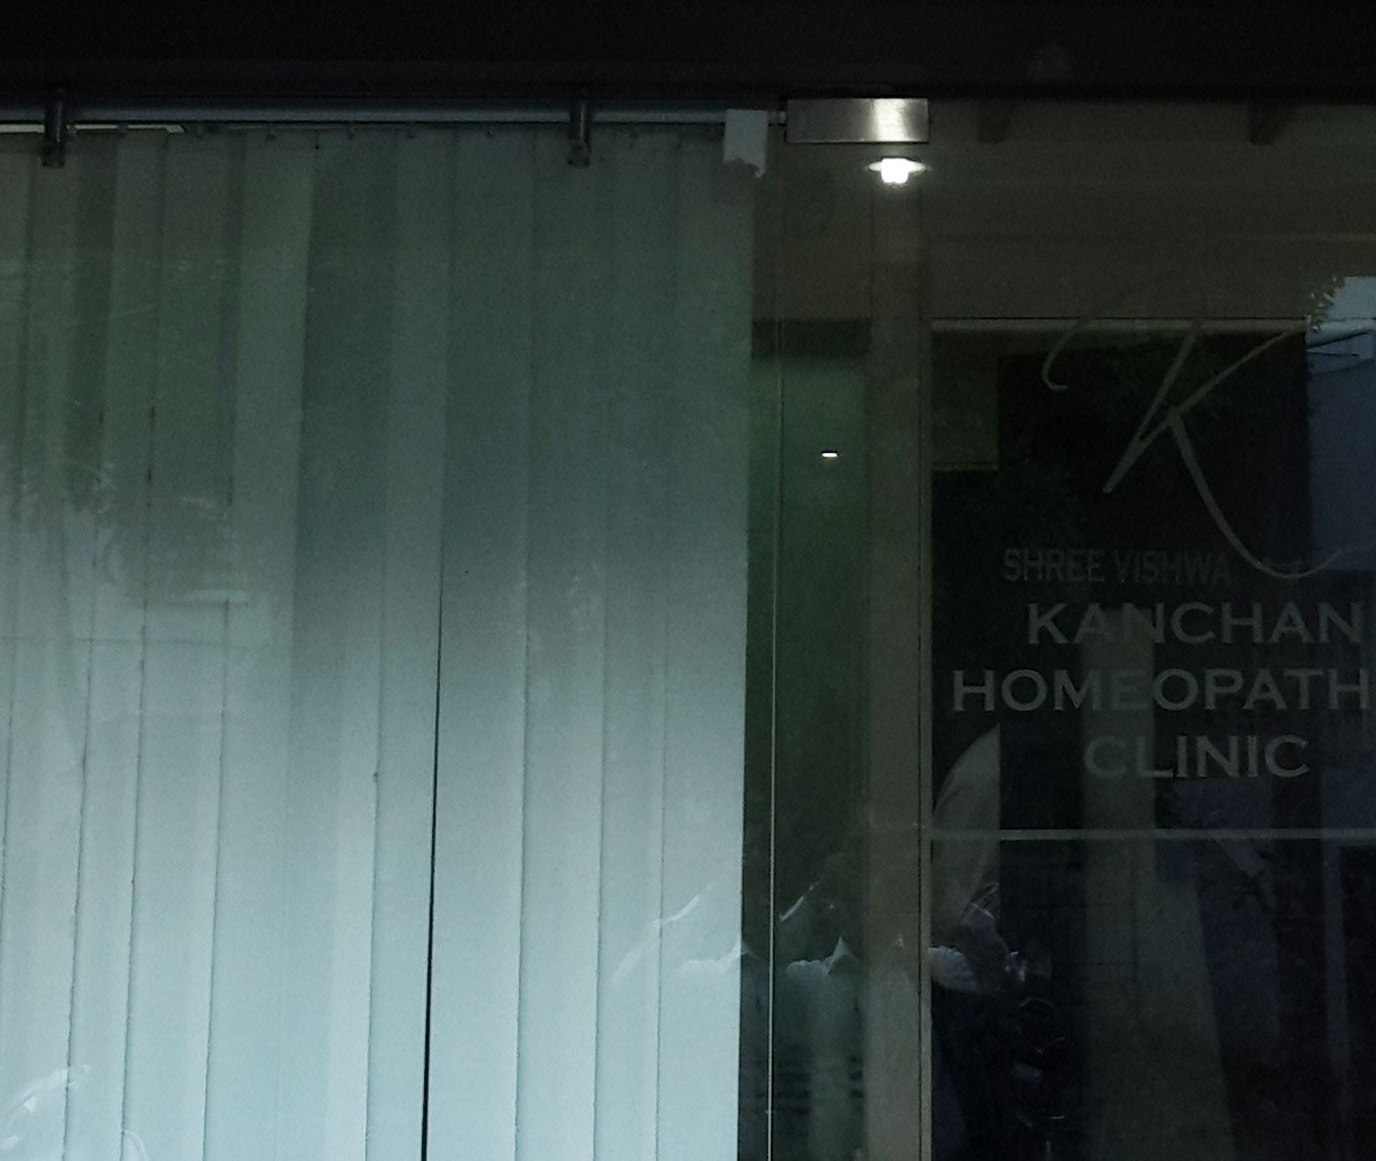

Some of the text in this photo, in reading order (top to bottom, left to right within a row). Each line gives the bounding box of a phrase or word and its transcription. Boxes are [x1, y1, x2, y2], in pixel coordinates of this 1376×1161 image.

[1001, 548, 1236, 585] SHREE VISHWA
[1026, 601, 1364, 645] KANCHAN
[1083, 735, 1310, 778] CLINIC
